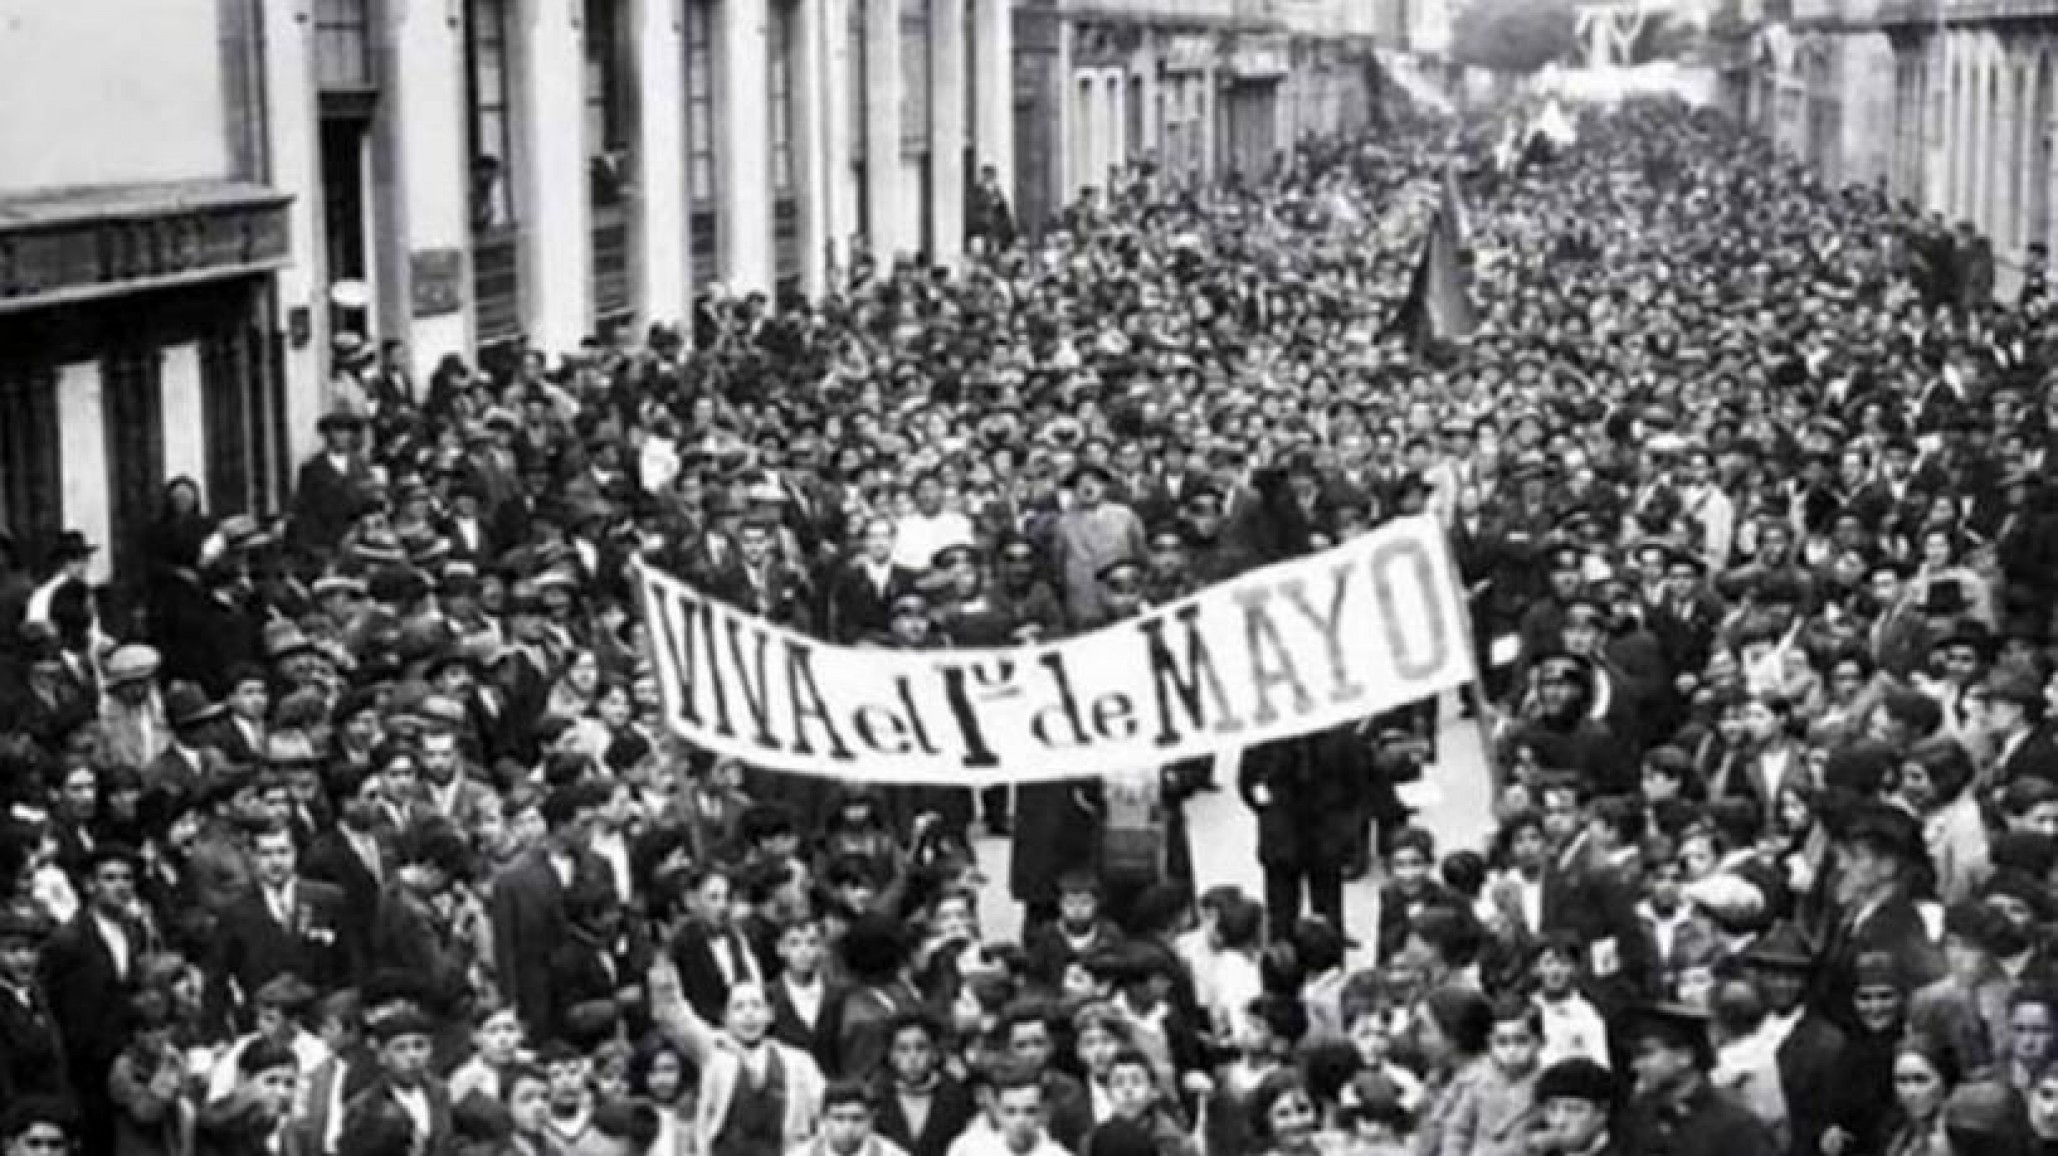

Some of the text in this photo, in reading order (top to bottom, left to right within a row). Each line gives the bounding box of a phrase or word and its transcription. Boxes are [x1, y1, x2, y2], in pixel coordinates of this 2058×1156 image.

[649, 582, 857, 760] VIVA
[852, 674, 941, 755] el
[1030, 652, 1139, 749] de
[1138, 539, 1447, 748] MAYO
